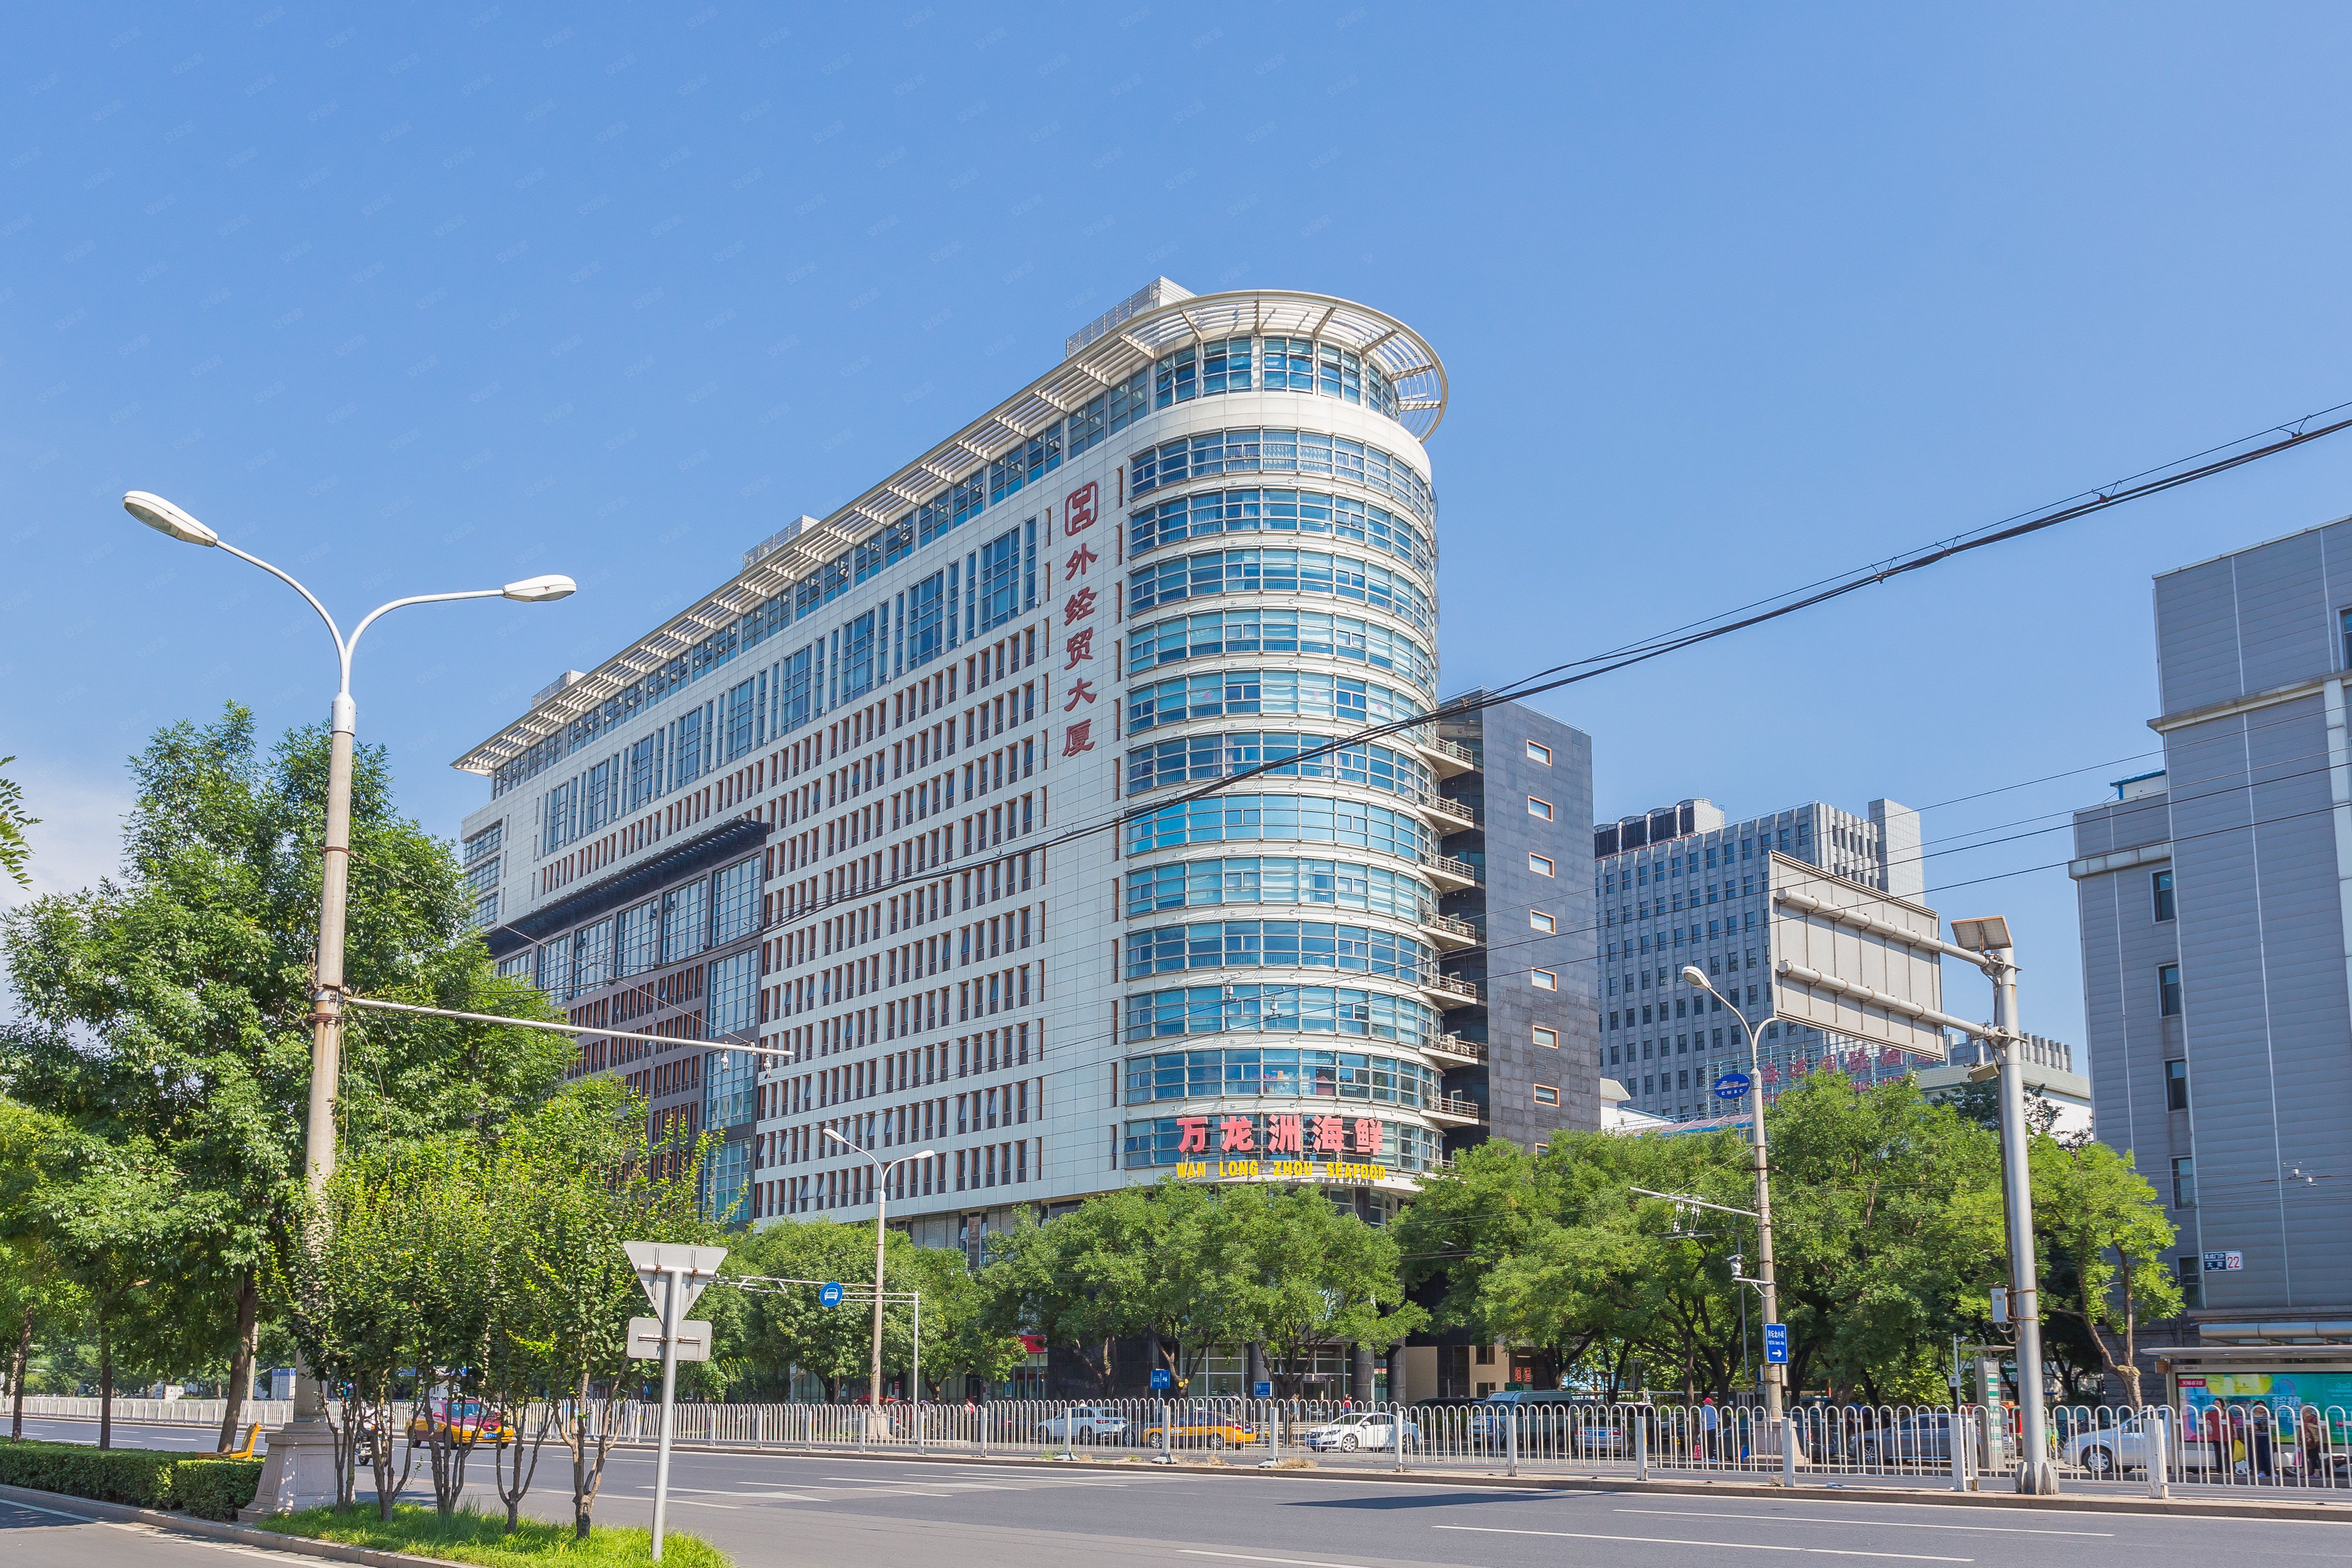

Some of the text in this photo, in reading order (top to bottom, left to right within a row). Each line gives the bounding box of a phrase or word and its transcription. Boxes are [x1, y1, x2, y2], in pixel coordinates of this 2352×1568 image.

[1062, 542, 1098, 757] 外经贸大厦
[1176, 1114, 1383, 1156] 万龙洲海鲜
[1176, 1160, 1386, 1180] WAN LONG ZHOU SEAFOOD
[2227, 1256, 2240, 1268] 22
